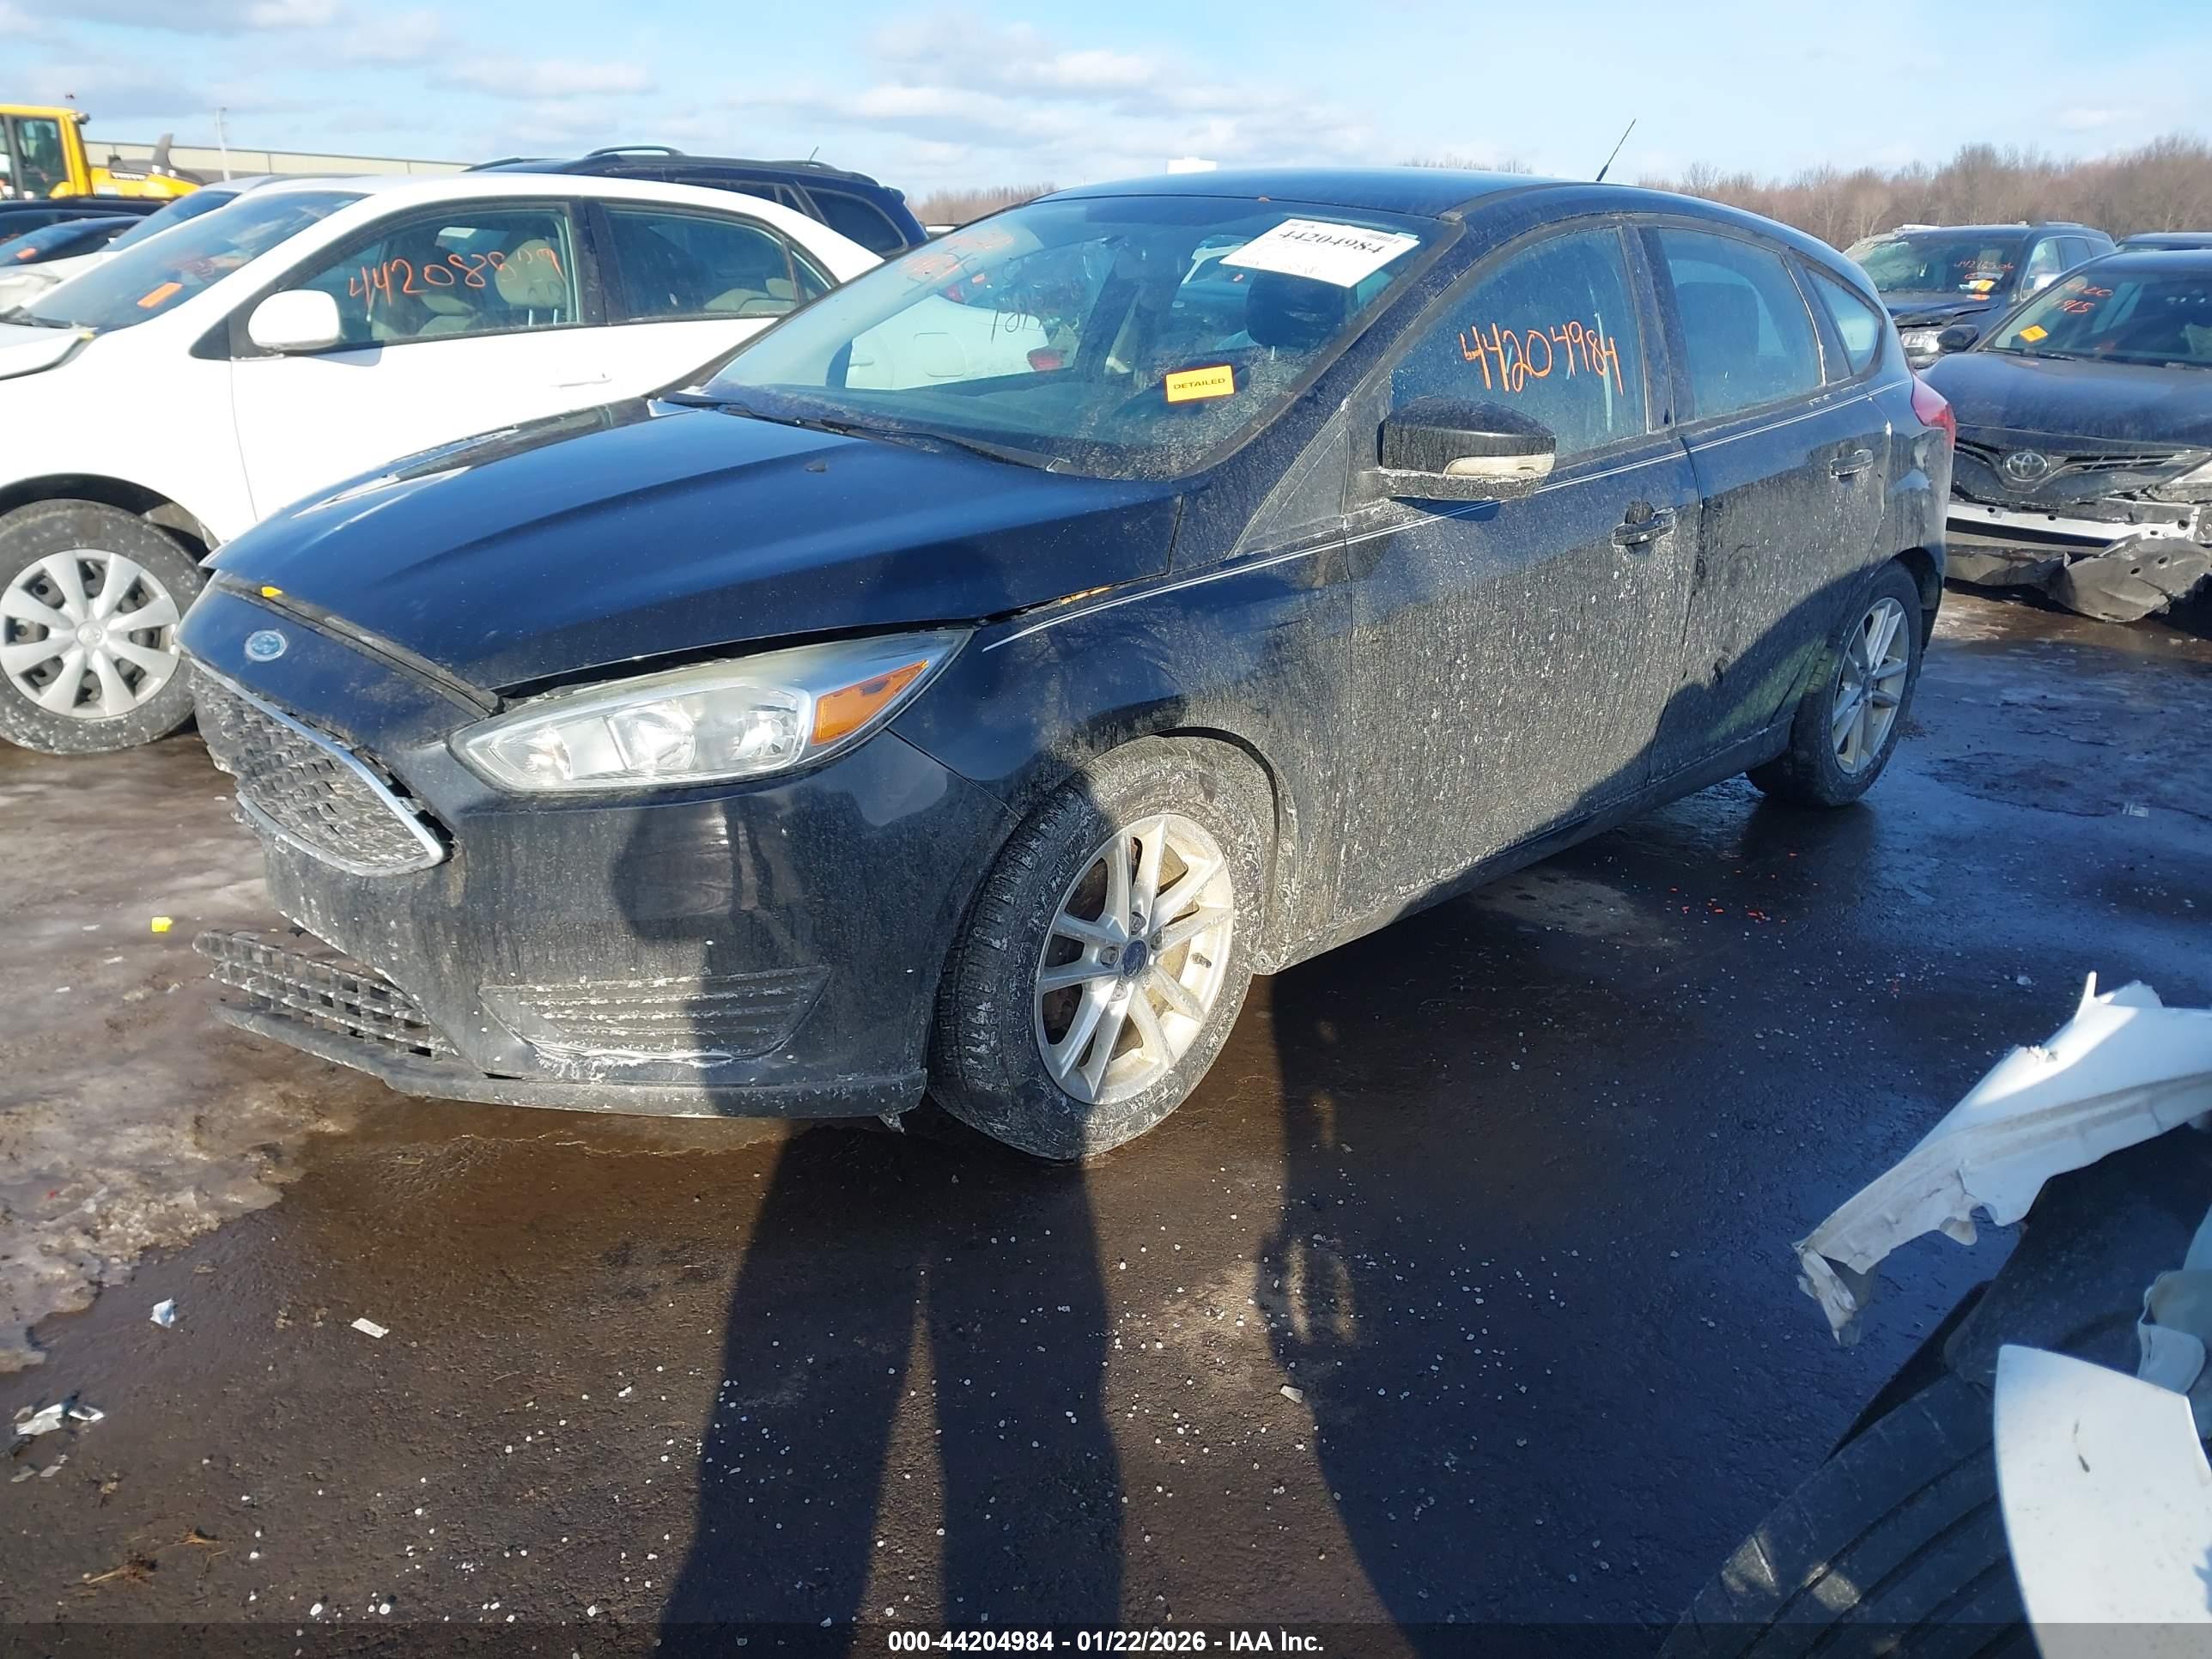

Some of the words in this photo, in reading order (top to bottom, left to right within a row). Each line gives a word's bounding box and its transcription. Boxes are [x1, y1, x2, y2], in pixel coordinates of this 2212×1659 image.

[1279, 230, 1386, 254] 44204984
[1459, 320, 1625, 398] 44204984
[1173, 378, 1226, 390] DETAILED
